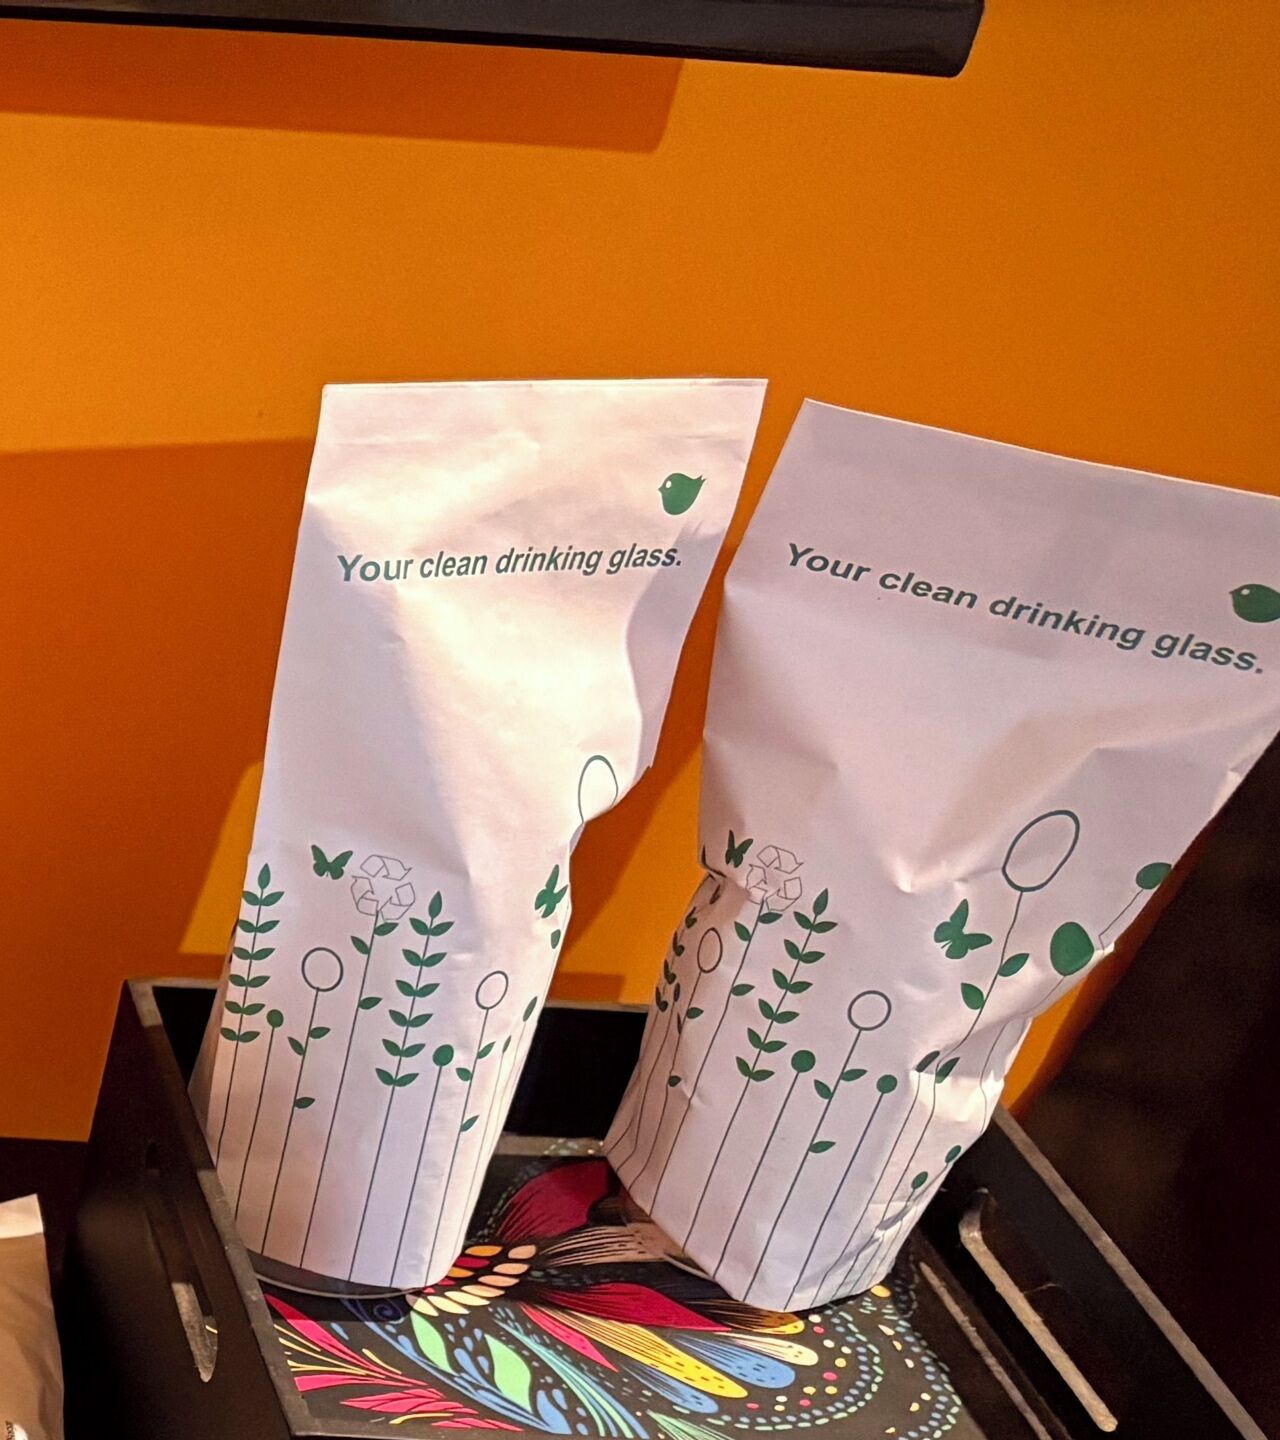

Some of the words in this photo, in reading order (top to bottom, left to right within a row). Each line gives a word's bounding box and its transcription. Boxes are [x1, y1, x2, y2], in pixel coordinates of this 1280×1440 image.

[336, 552, 414, 582] Your
[419, 550, 488, 579] clean
[495, 544, 604, 577] drinking
[605, 542, 682, 575] glass.
[788, 542, 872, 583] Your
[878, 571, 978, 610] clean
[989, 595, 1146, 651] drinking
[1151, 633, 1263, 675] glass.
